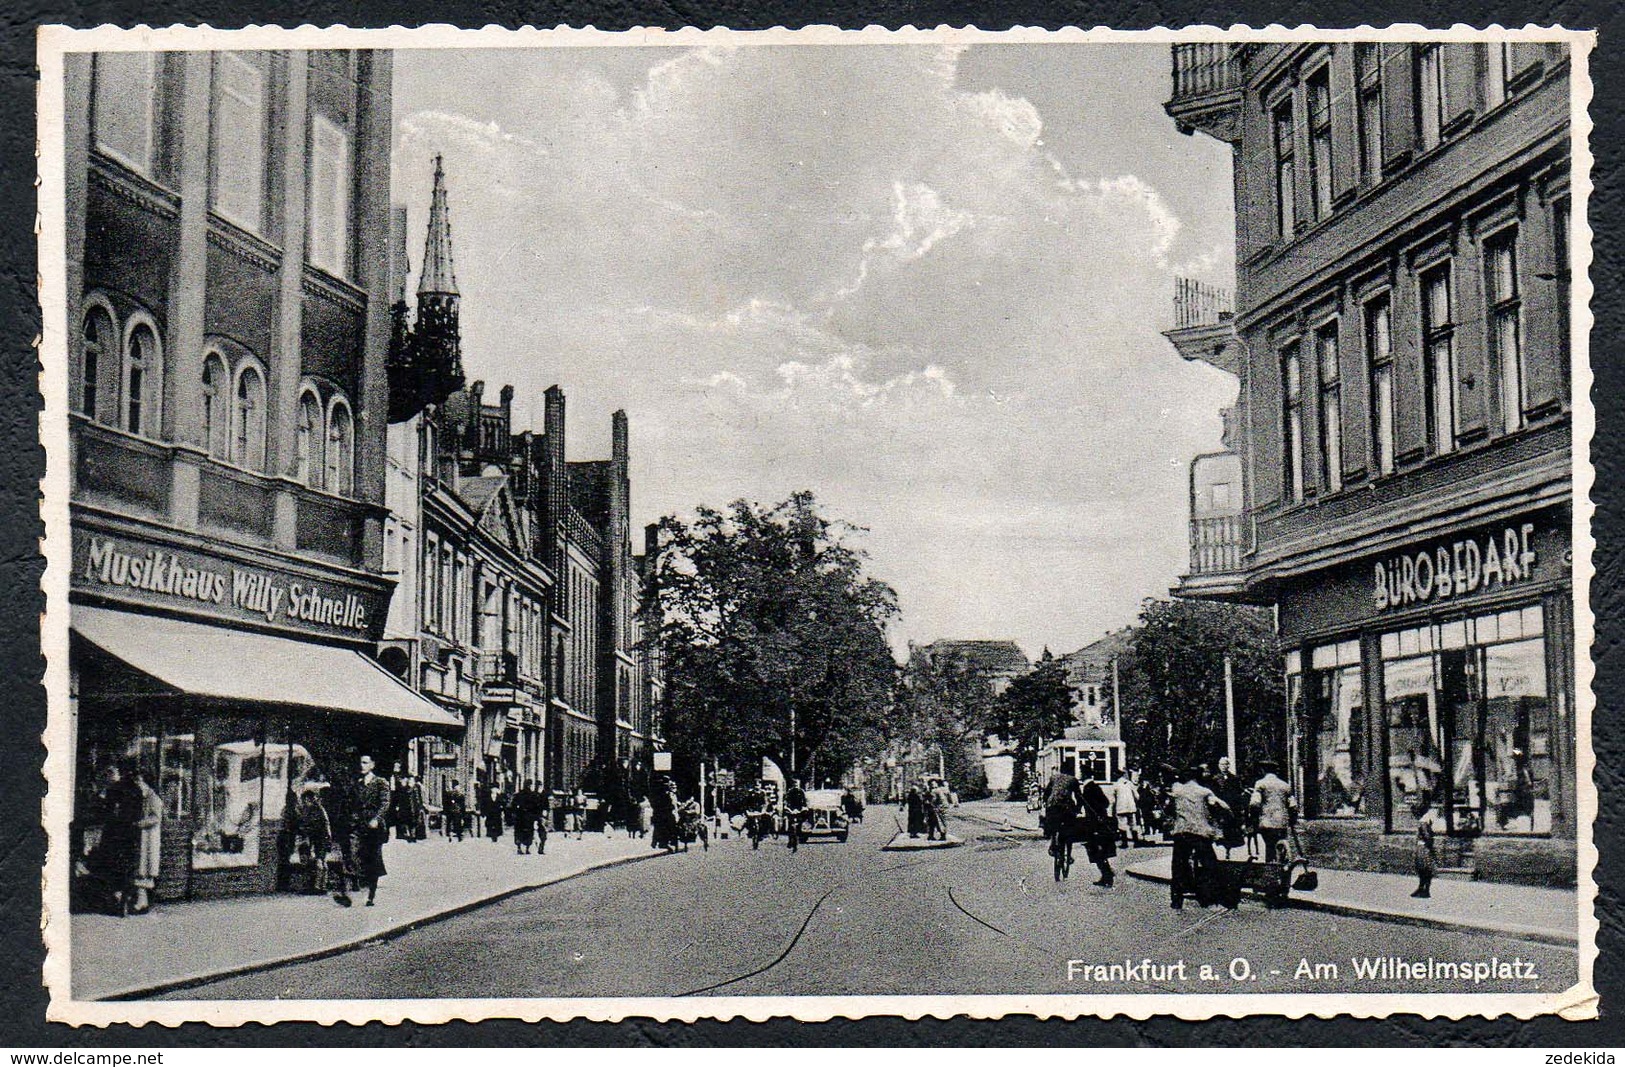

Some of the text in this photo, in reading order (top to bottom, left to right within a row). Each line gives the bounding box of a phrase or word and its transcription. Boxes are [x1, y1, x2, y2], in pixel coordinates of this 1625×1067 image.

[84, 539, 226, 604] Musikhaus
[232, 569, 284, 622] Willy
[1373, 523, 1536, 611] BÜROBEDARF
